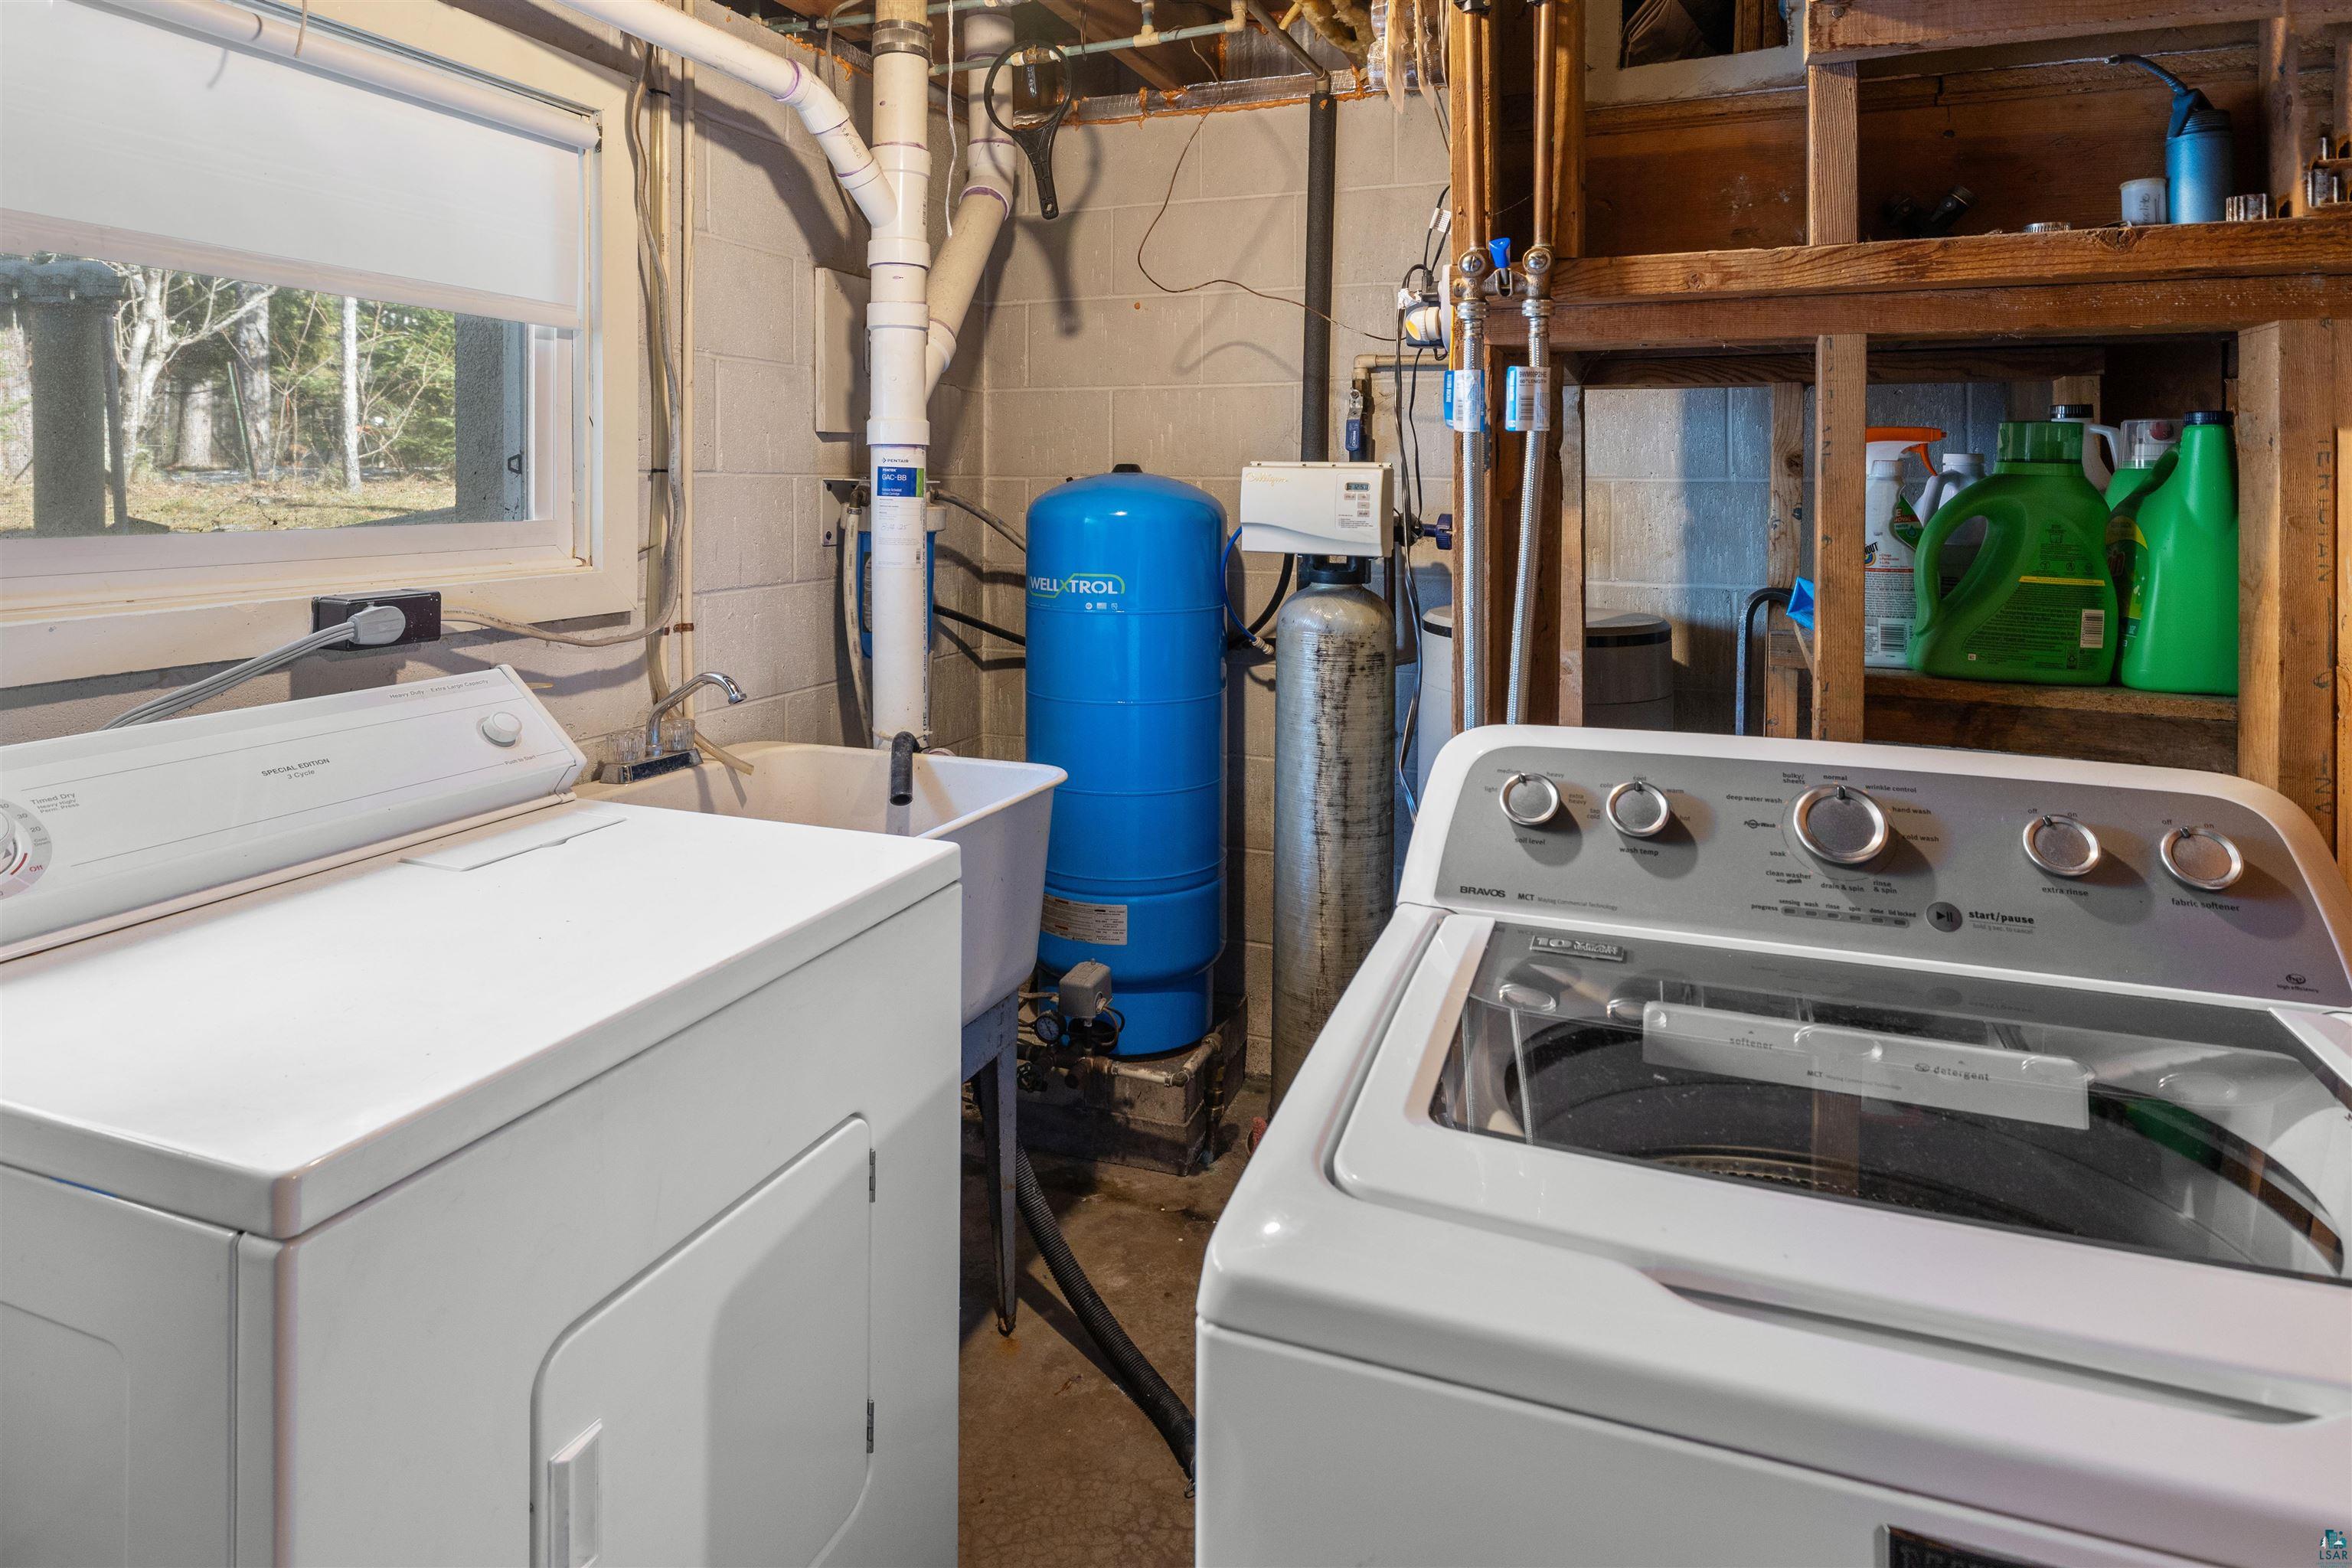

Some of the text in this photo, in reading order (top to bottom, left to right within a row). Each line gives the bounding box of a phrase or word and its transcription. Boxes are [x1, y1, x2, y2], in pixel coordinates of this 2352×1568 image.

[464, 679, 489, 688] Capacity
[261, 758, 331, 776] SPECIAL EDITION
[293, 769, 315, 779] Cycle
[31, 795, 59, 805] Timed
[1619, 846, 1659, 857] wash temp
[29, 864, 44, 873] Off
[1766, 870, 1785, 878] clean
[1459, 885, 1507, 898] BRAVOS
[2042, 886, 2089, 897] extra rinse
[1517, 893, 1619, 911] MCT Maytag Commercial Technology
[1751, 903, 1779, 912] progress
[1779, 899, 1801, 907] sensing
[2171, 897, 2240, 913] fabric softener
[1896, 910, 1917, 918] locked
[1968, 910, 2035, 925] start/pause
[1537, 936, 1573, 948] 10
[1729, 1036, 1775, 1050] softener
[1806, 1069, 1823, 1078] MCT
[1933, 1066, 1991, 1082] detergent
